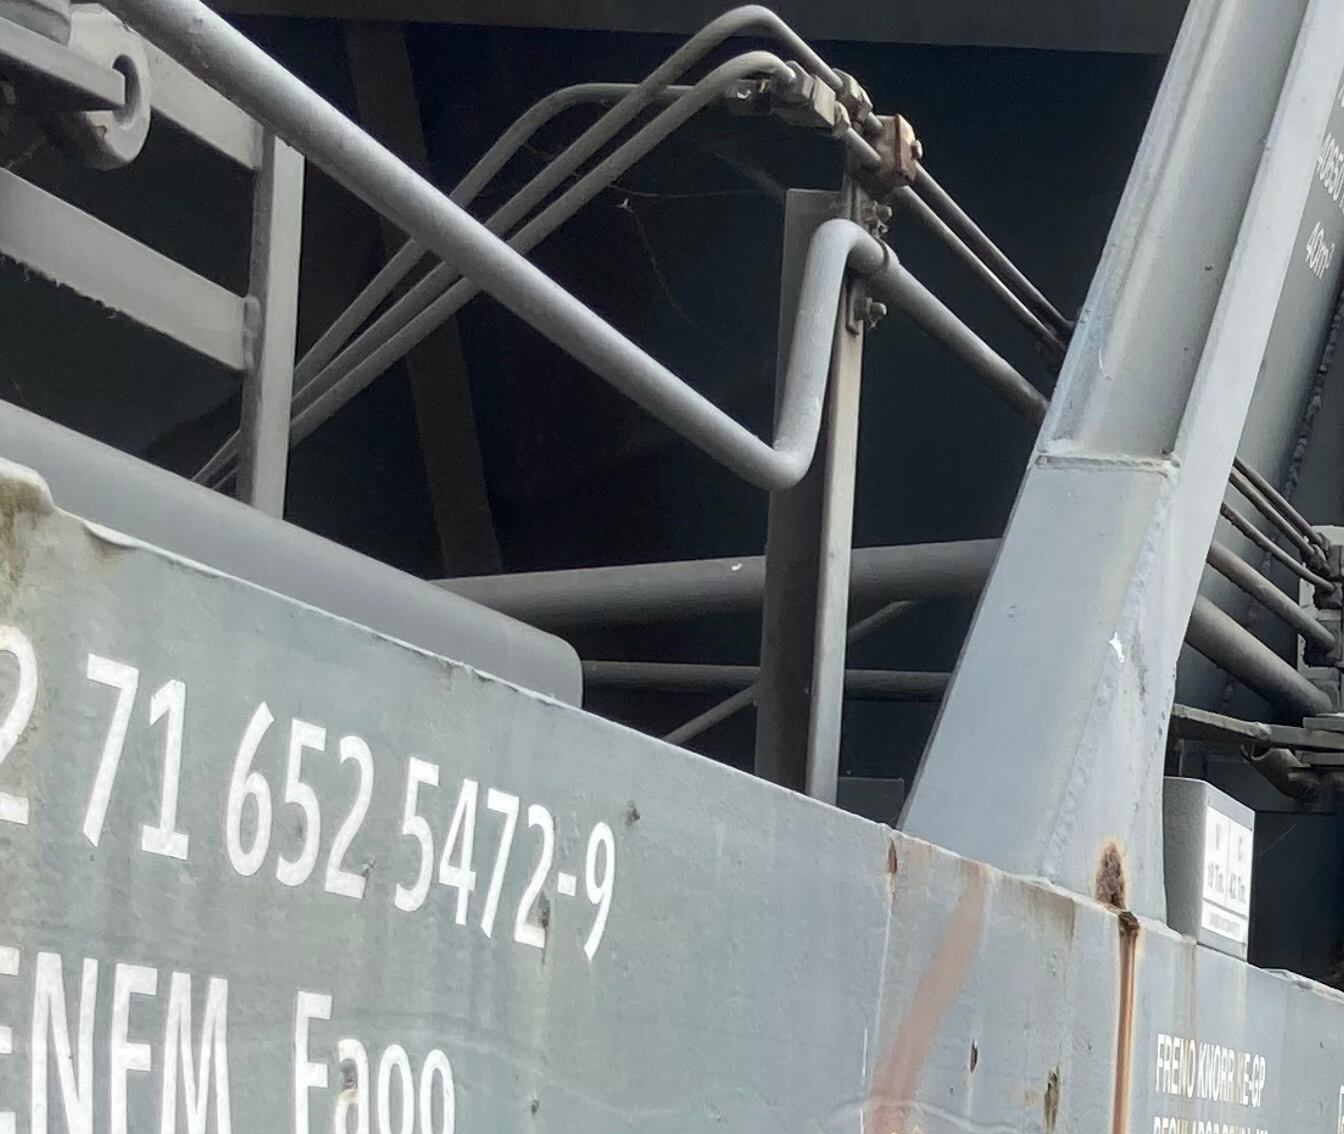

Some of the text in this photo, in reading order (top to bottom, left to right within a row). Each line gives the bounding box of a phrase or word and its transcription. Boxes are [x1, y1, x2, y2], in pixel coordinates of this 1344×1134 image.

[83, 653, 190, 861] 71
[226, 702, 375, 899] 652
[395, 757, 616, 961] 5472-9
[1156, 1033, 1196, 1098] FRENO
[1197, 1043, 1236, 1103] KNORR
